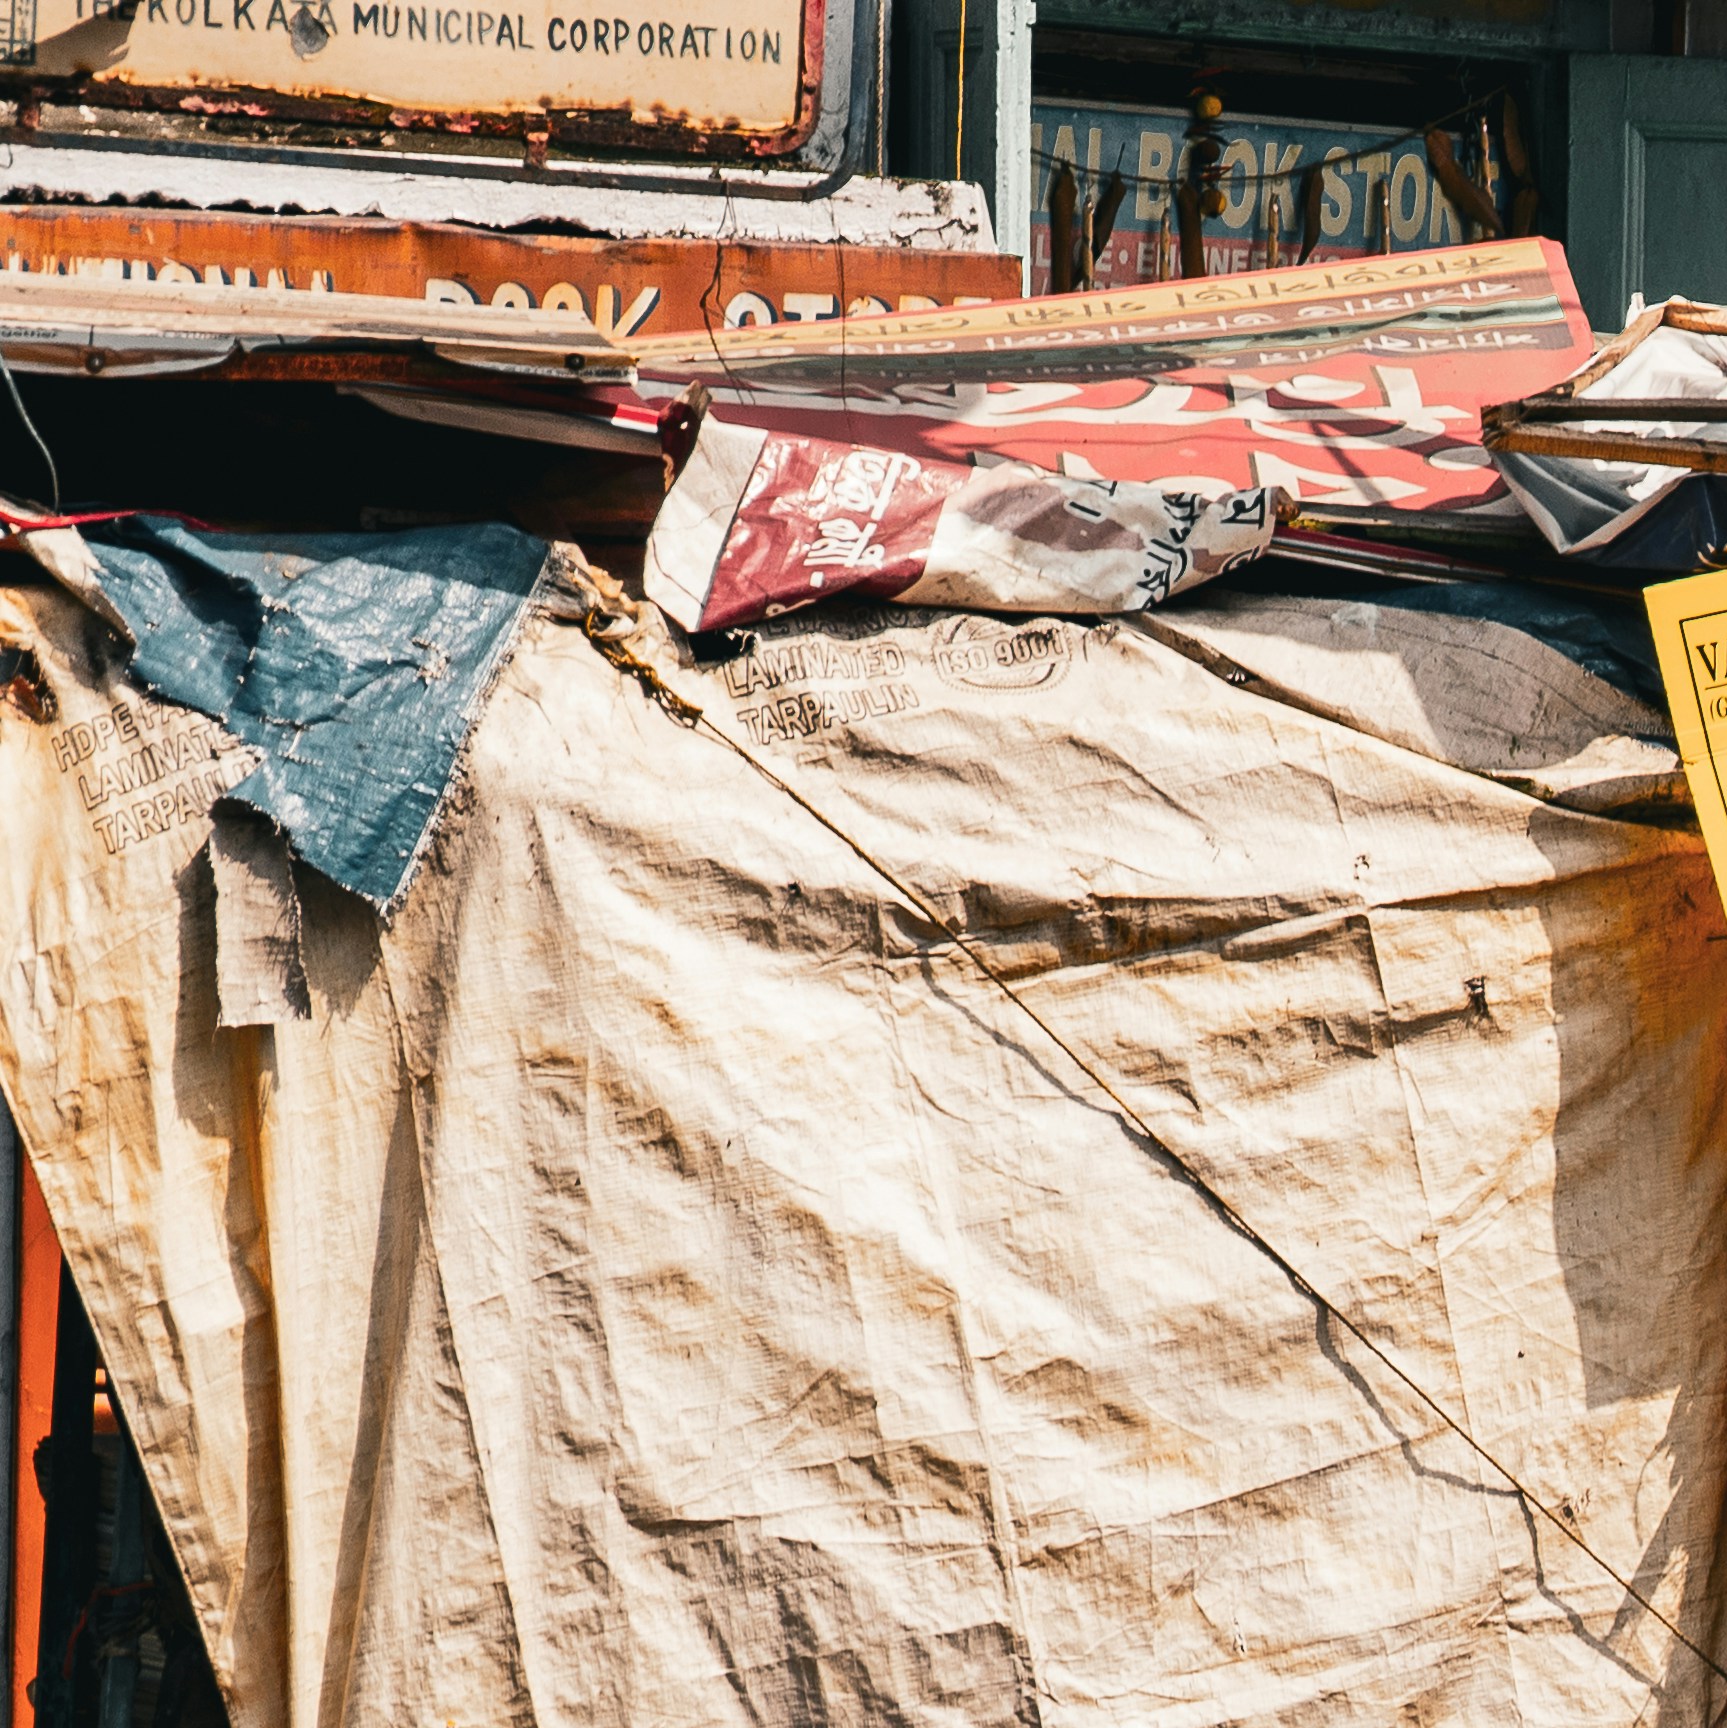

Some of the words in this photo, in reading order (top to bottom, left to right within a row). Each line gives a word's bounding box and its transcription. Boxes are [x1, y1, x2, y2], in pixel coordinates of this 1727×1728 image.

[352, 2, 536, 52] MUNICIPAL
[547, 18, 782, 64] CORPORATION
[1136, 131, 1303, 232] BOK
[1319, 146, 1499, 245] STOR
[724, 640, 907, 698] LAMINATED
[938, 644, 989, 674] ISO
[995, 630, 1066, 669] 9001
[51, 698, 140, 773] HDPE
[736, 684, 921, 748] TARPAULIN
